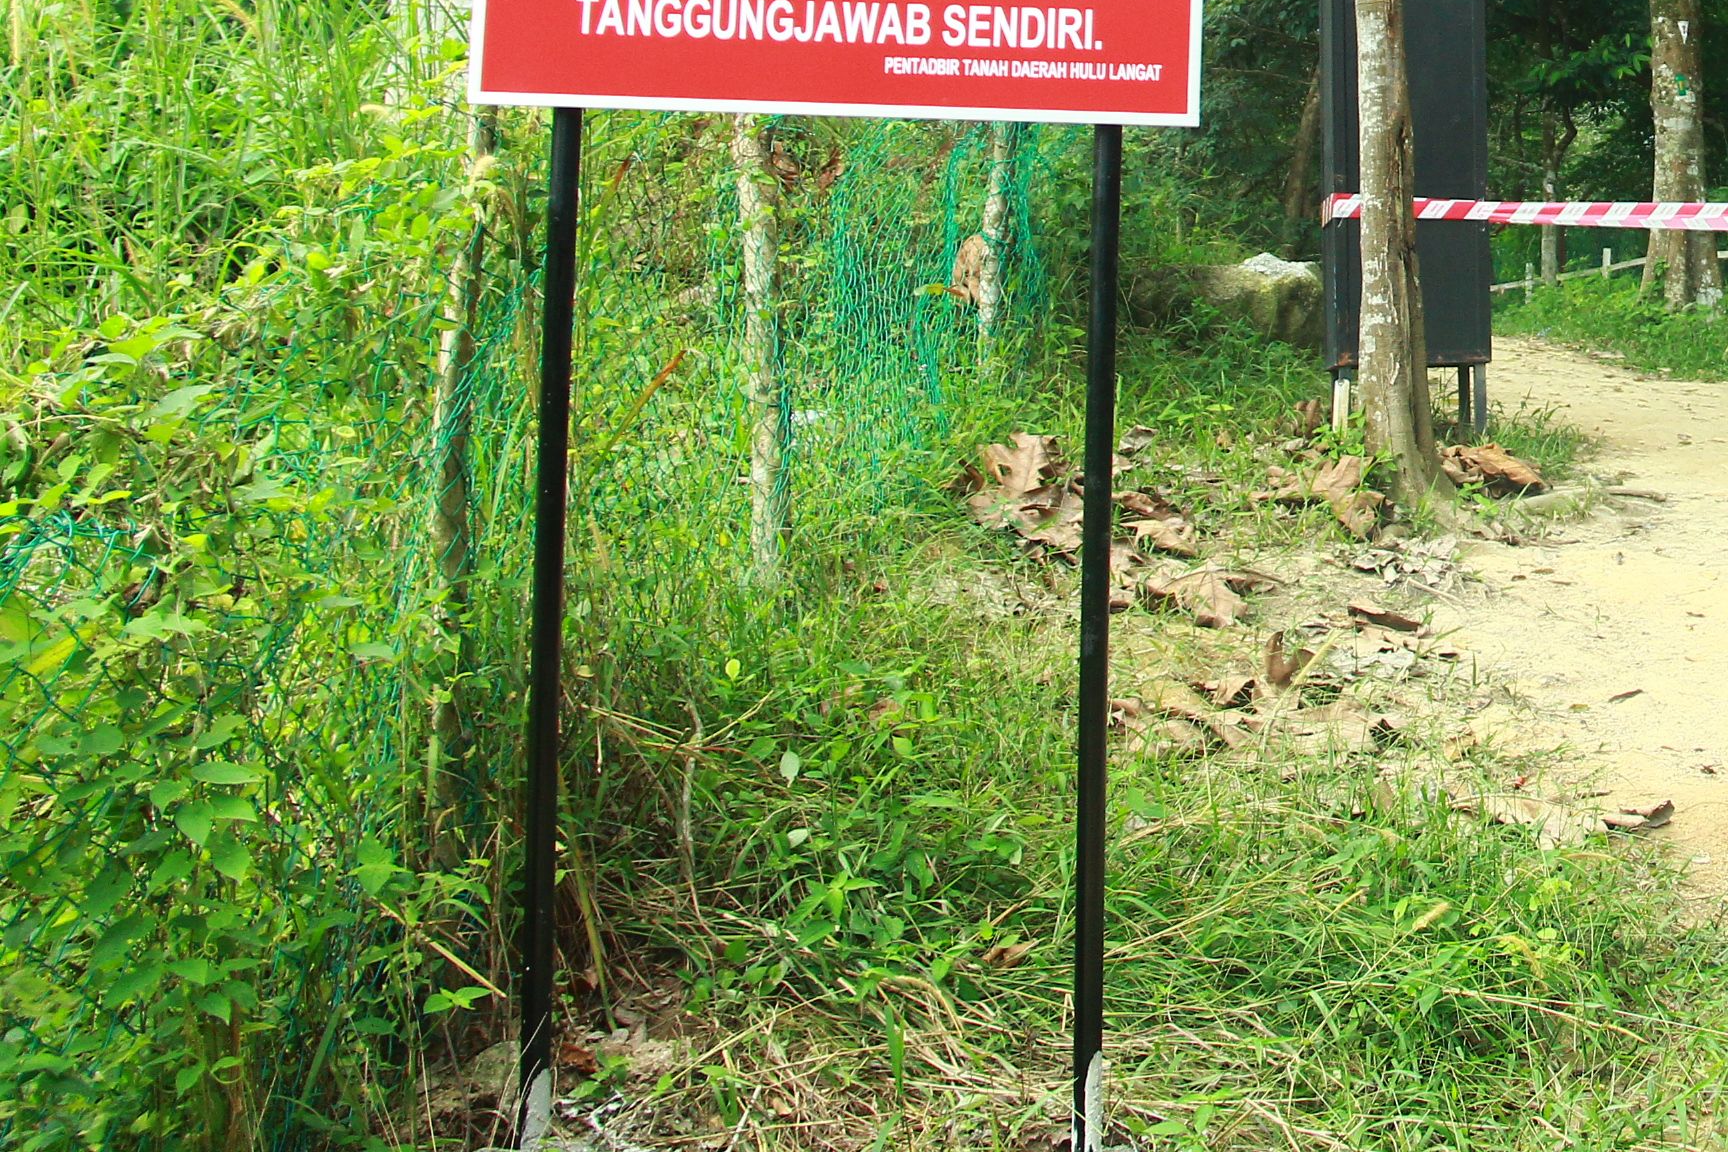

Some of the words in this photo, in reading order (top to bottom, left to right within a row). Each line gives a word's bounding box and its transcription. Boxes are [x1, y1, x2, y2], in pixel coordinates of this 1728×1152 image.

[943, 5, 1102, 49] SENDIRI.
[884, 56, 960, 76] PENTADBIR
[962, 58, 1009, 77] TANAH
[1011, 60, 1068, 79] DAERAH
[1069, 61, 1107, 80] HULU
[1108, 63, 1163, 81] LANGAT
